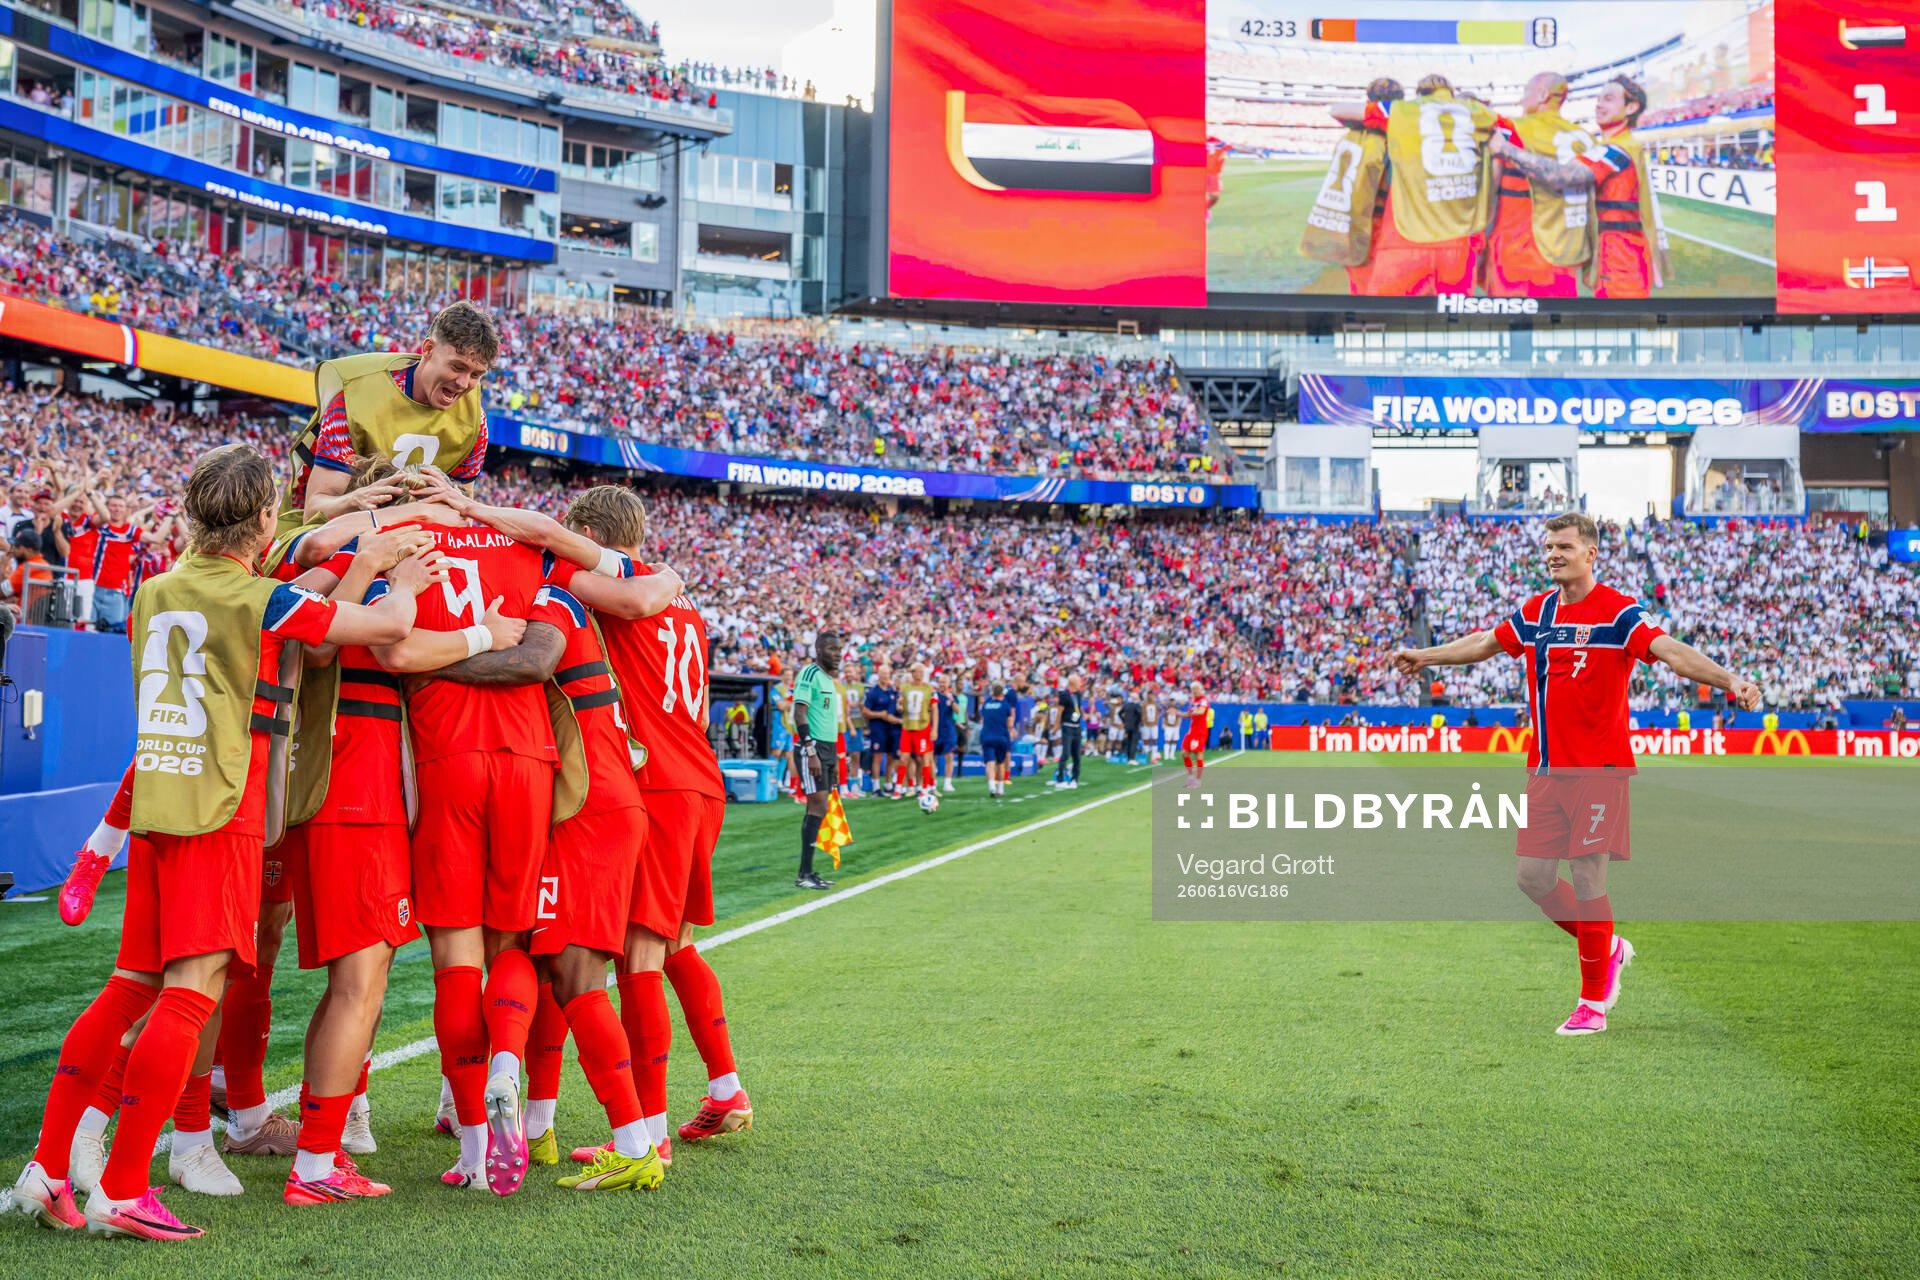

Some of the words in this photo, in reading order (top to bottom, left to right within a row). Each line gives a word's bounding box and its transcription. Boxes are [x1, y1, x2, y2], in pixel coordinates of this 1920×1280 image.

[1240, 20, 1296, 37] 42:33
[1854, 83, 1897, 125] 1
[1855, 180, 1897, 222] 1
[1437, 293, 1539, 314] Hisense
[1372, 395, 1441, 423] FIFA
[1443, 396, 1559, 424] WORLD
[1561, 398, 1626, 425] CUP
[1629, 398, 1745, 426] 2026
[1826, 391, 1920, 418] BOST
[727, 462, 763, 482] FIFA
[763, 465, 825, 490] WORLD
[825, 471, 861, 491] CUP
[861, 474, 926, 496] 2026
[447, 532, 515, 549] HAALAND
[436, 556, 486, 626] 9
[657, 616, 705, 722] 10
[1571, 650, 1588, 678] 7
[149, 709, 188, 726] FIFA
[137, 739, 174, 752] ORLD
[176, 741, 207, 755] CUP
[1309, 726, 1353, 752] i'm
[1358, 727, 1435, 753] lovin'
[1440, 727, 1462, 753] it
[1630, 729, 1698, 755] ovin'
[1703, 728, 1727, 755] it
[1838, 730, 1884, 757] i'm
[1890, 731, 1920, 757] lo
[135, 753, 204, 776] 026
[1590, 803, 1606, 833] 7
[537, 876, 559, 919] 2
